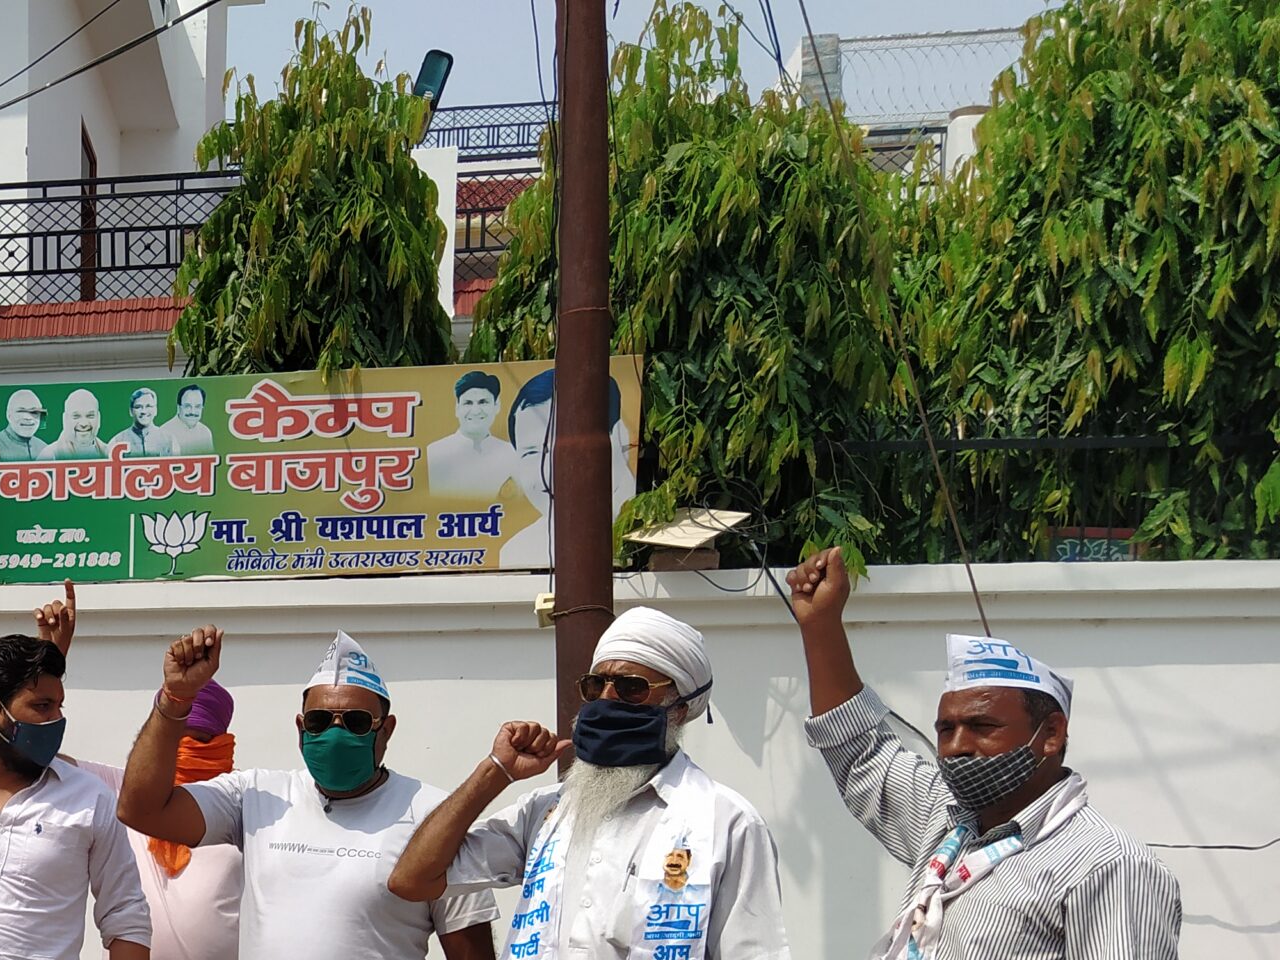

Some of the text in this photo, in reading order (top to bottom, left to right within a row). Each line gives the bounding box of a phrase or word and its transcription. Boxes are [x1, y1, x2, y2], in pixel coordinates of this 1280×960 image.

[227, 379, 419, 440] कैम्प
[227, 449, 419, 512] बाजपुर
[210, 504, 503, 543] मा. श्री यशपाल आर्य
[227, 548, 486, 571] कैबिनेट मंत्री उत्तराखण्ड सरकार
[523, 878, 545, 899] आम
[512, 901, 550, 929] आदमी
[646, 904, 706, 931] आप
[510, 932, 541, 959] पार्टी
